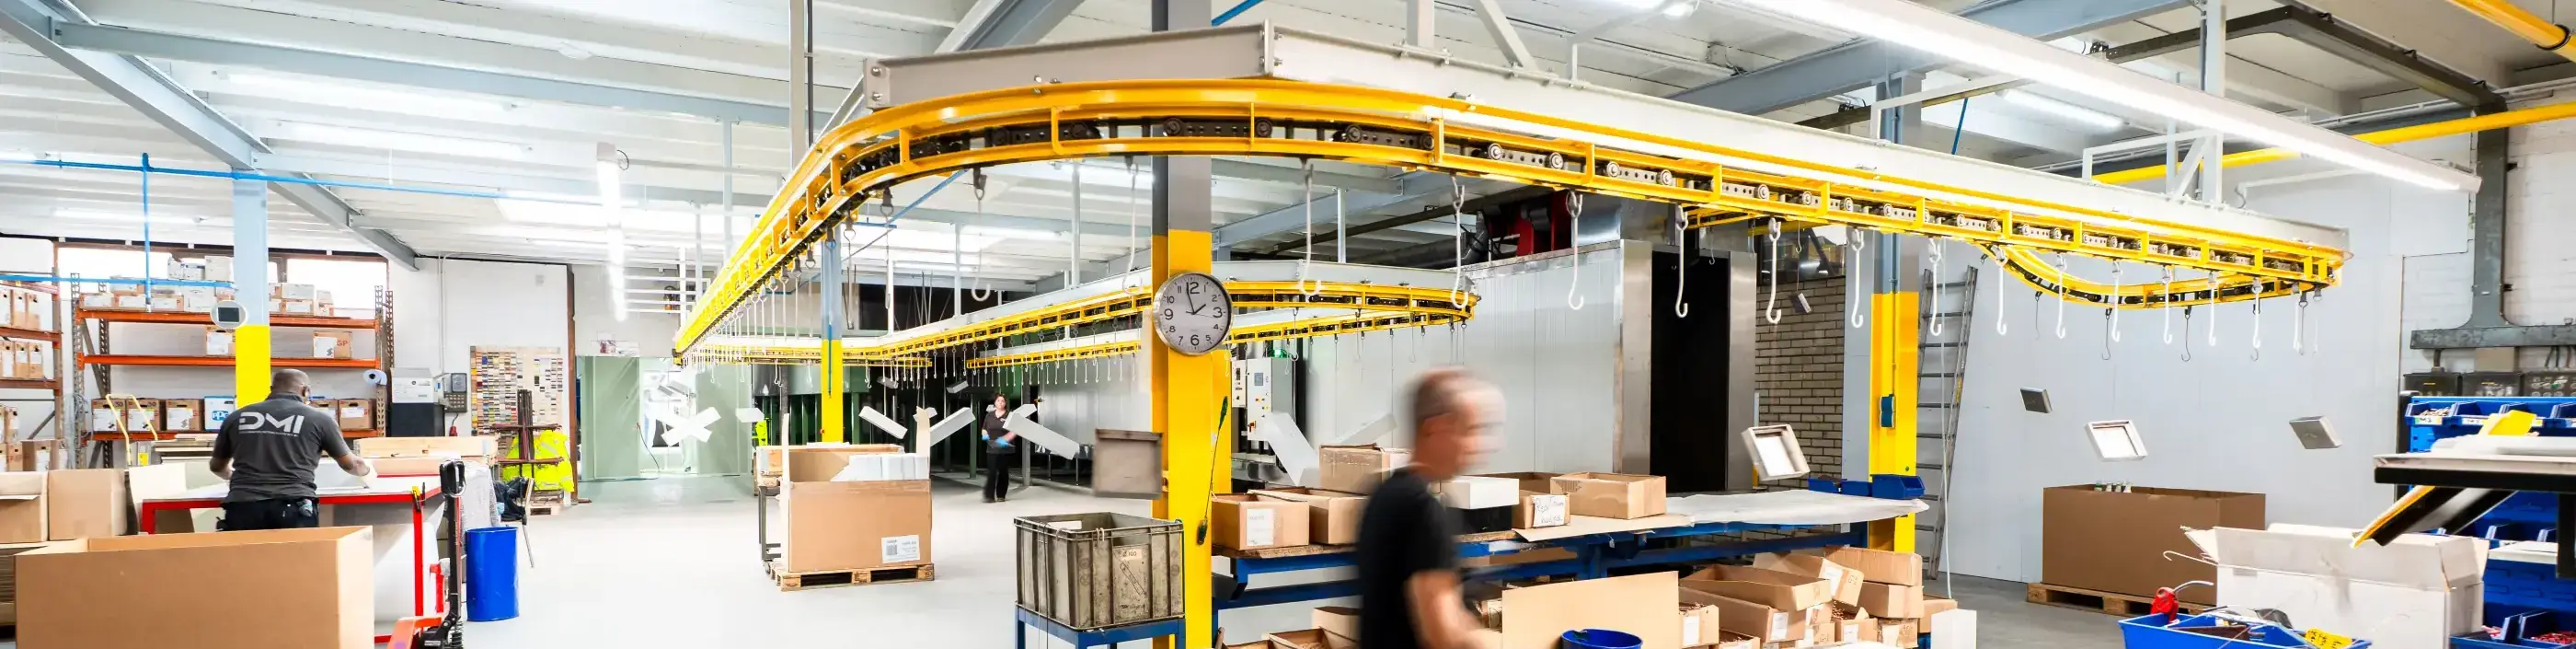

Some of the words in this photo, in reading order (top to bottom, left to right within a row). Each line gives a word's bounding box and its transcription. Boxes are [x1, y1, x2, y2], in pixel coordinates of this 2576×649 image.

[1186, 282, 1201, 294] 12
[1164, 308, 1173, 319] 9
[1213, 307, 1222, 318] 3
[1190, 334, 1199, 345] 6
[238, 411, 305, 434] DMI
